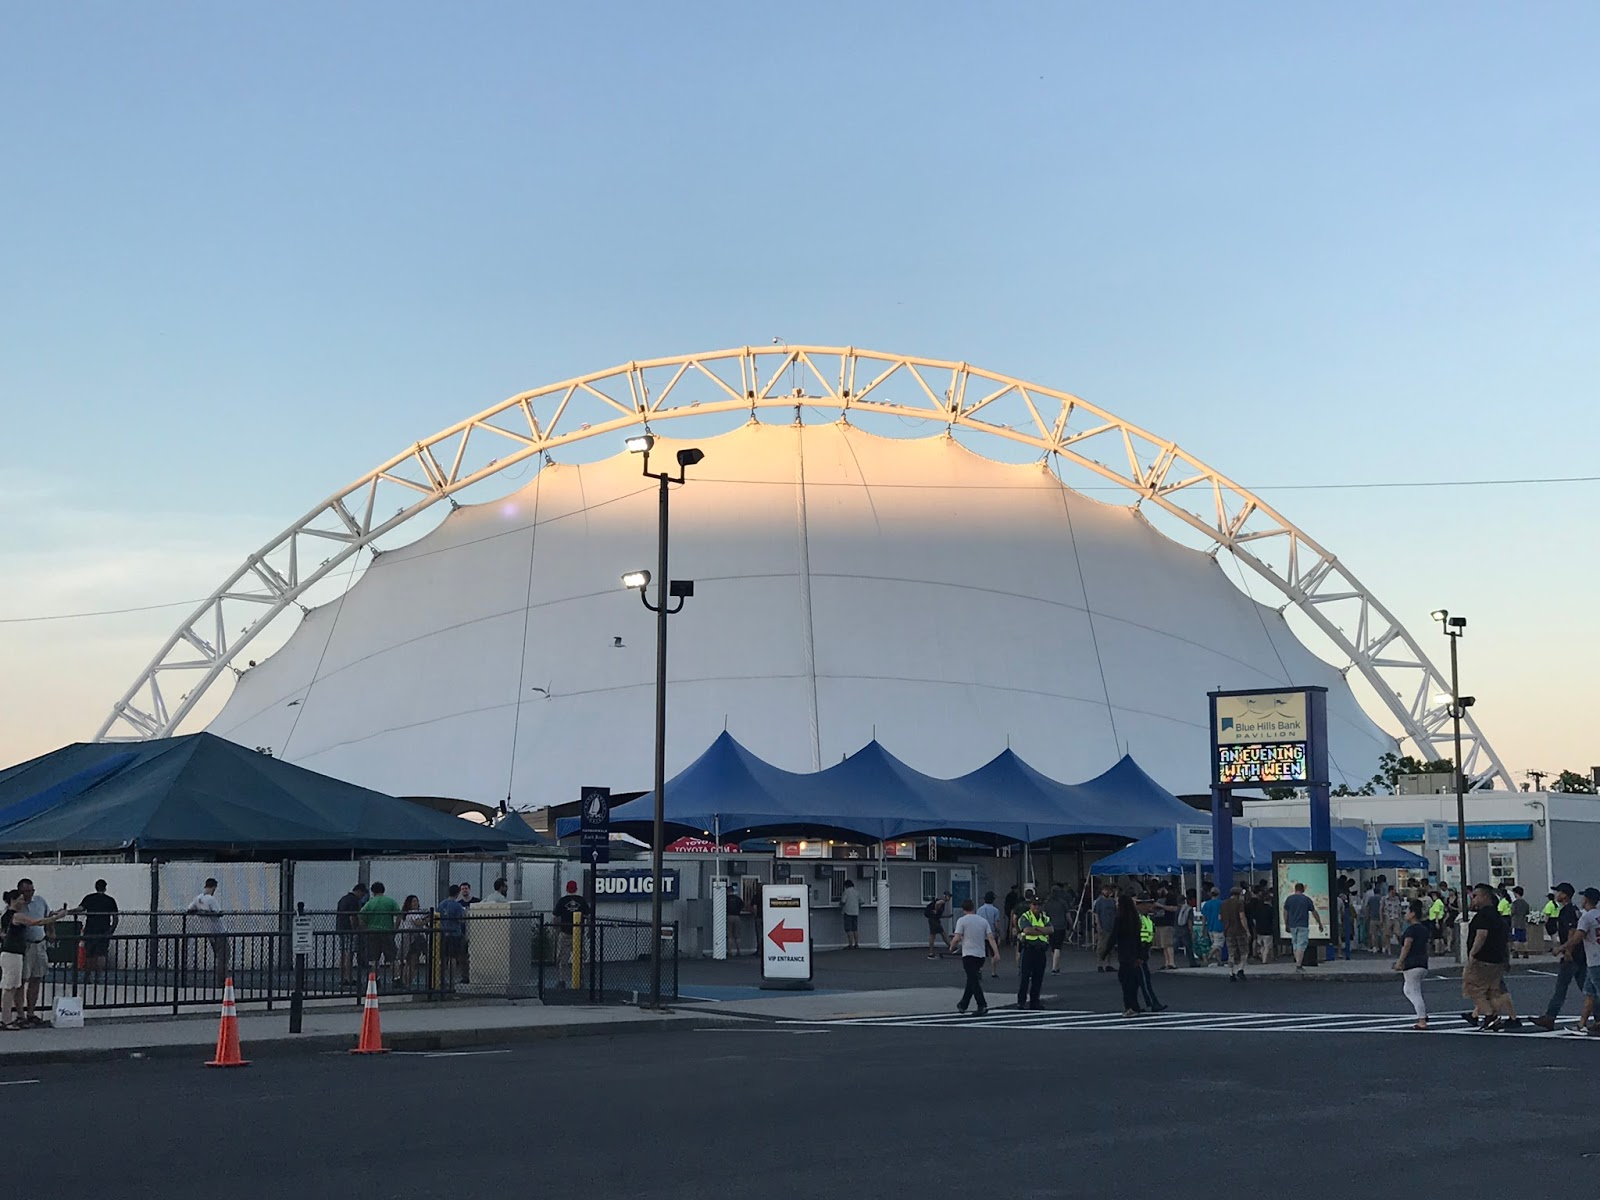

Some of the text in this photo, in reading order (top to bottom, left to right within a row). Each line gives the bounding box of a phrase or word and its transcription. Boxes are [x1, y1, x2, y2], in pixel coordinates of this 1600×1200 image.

[1236, 720, 1300, 732] Blue Hills Bank
[1220, 748, 1303, 762] AN EVENING
[1224, 762, 1301, 776] WITH WEEN
[595, 876, 674, 894] BUD LIGT
